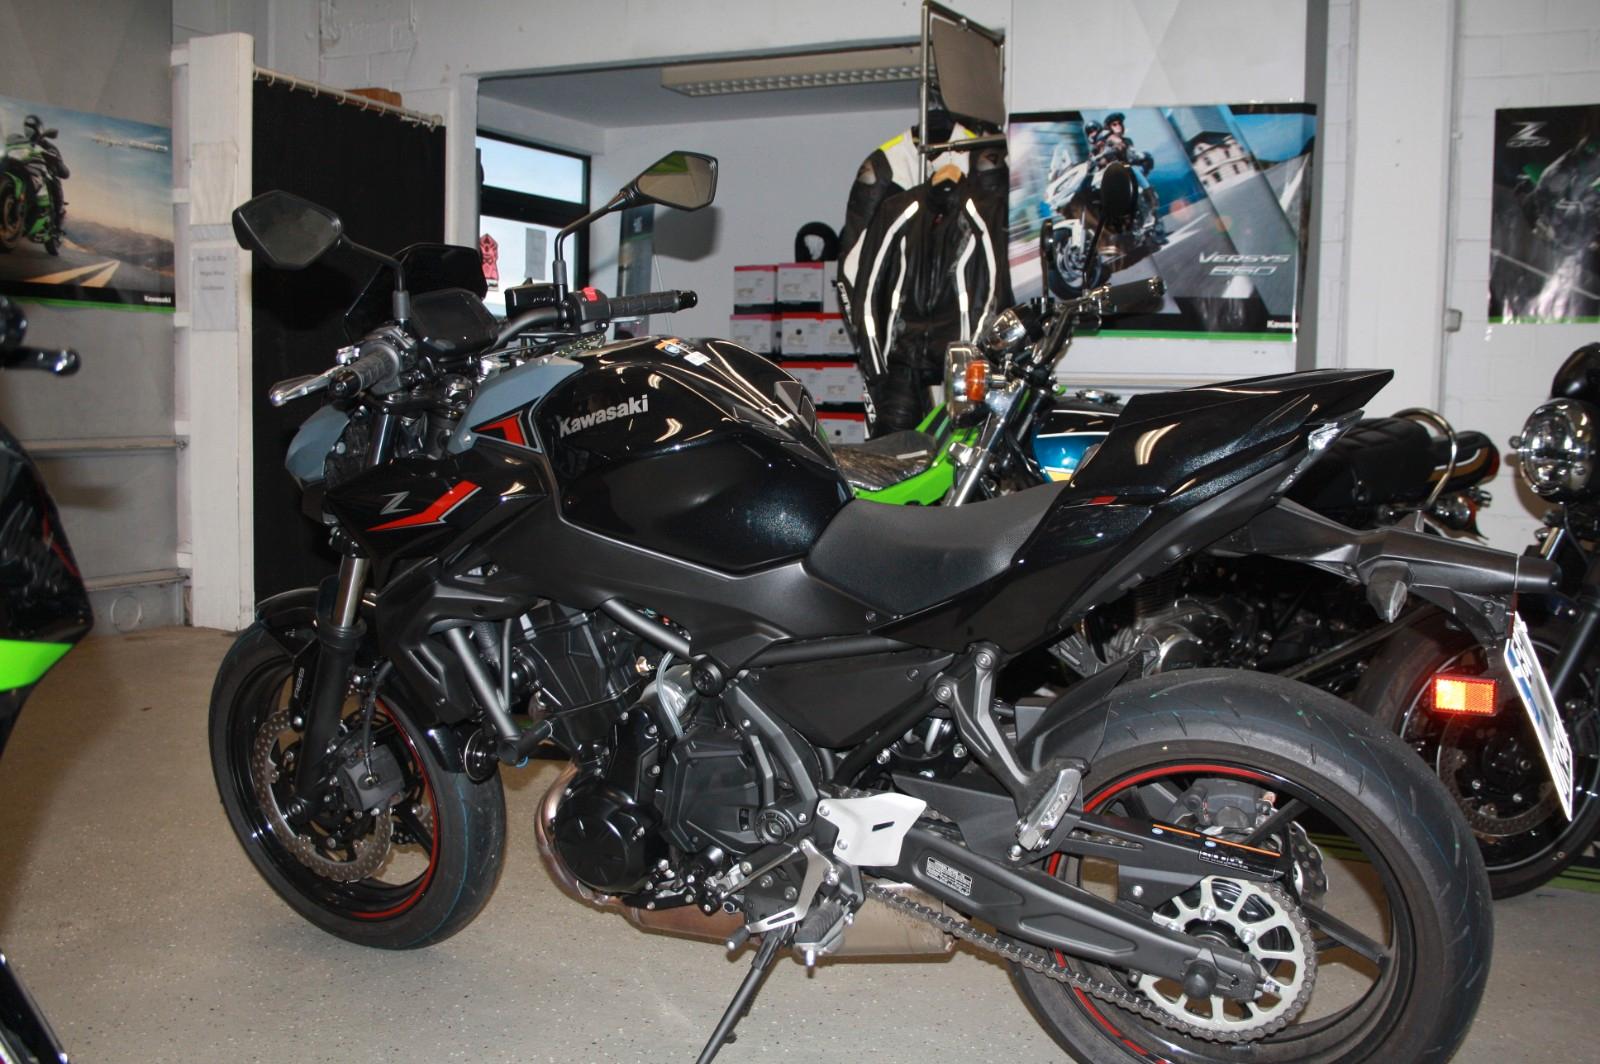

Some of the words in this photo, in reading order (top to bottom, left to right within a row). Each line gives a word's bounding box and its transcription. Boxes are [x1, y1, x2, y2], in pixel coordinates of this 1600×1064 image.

[1199, 251, 1291, 264] VERSYS
[1209, 265, 1277, 276] 650
[557, 394, 648, 438] Kawasaki
[380, 490, 412, 515] Z
